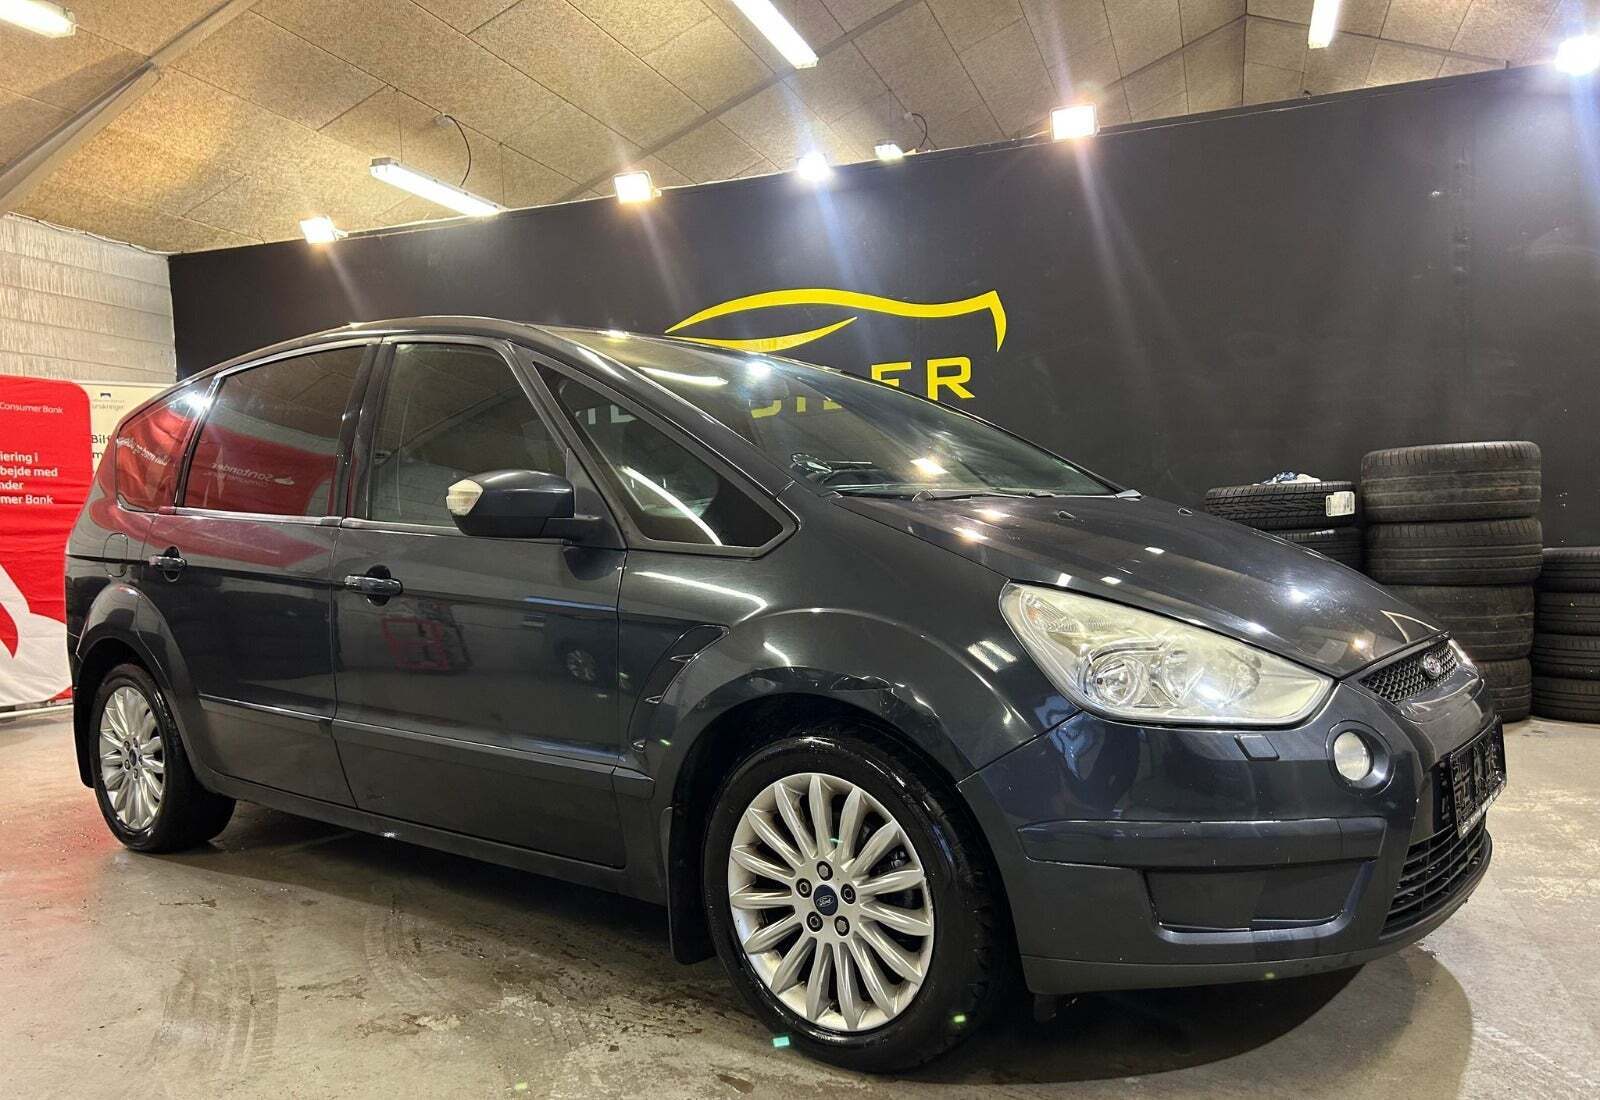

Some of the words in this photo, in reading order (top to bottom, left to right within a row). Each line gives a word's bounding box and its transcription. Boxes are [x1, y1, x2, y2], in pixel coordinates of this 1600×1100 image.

[43, 405, 64, 414] Bank
[33, 467, 58, 477] med
[25, 494, 54, 505] Bank
